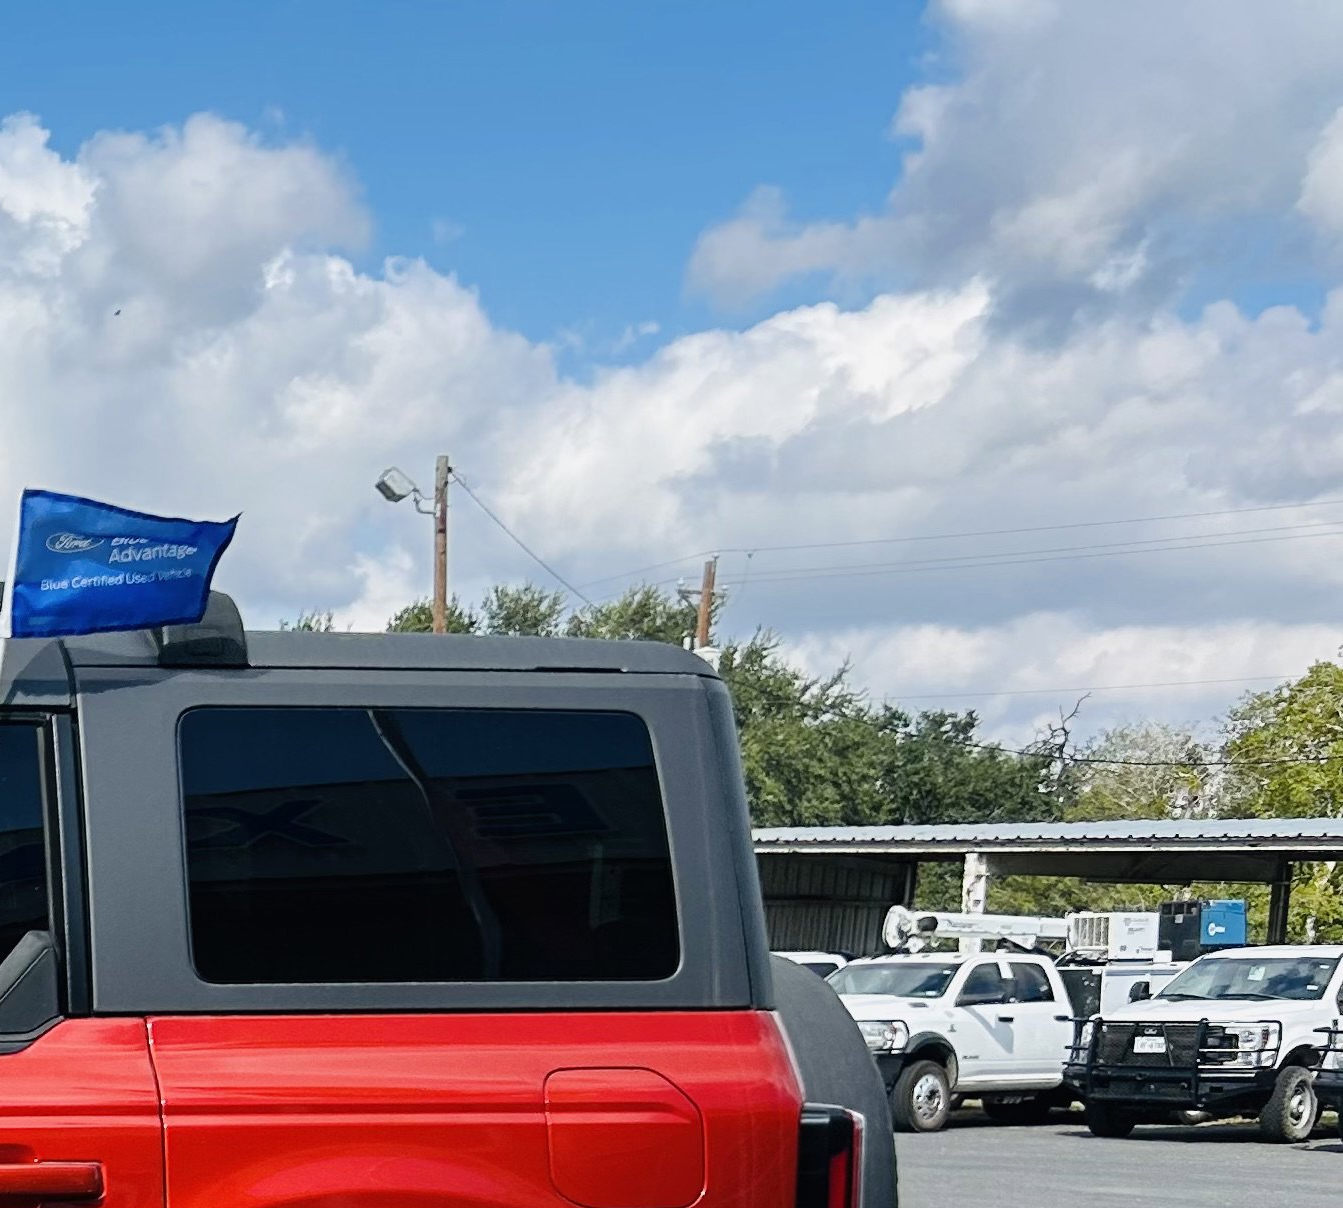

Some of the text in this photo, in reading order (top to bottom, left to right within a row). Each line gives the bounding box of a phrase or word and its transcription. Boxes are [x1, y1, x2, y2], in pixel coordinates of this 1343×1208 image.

[54, 533, 93, 549] Ford
[109, 543, 197, 564] Advantage
[41, 579, 68, 591] Blue
[71, 572, 123, 588] Certified
[125, 571, 155, 585] Used
